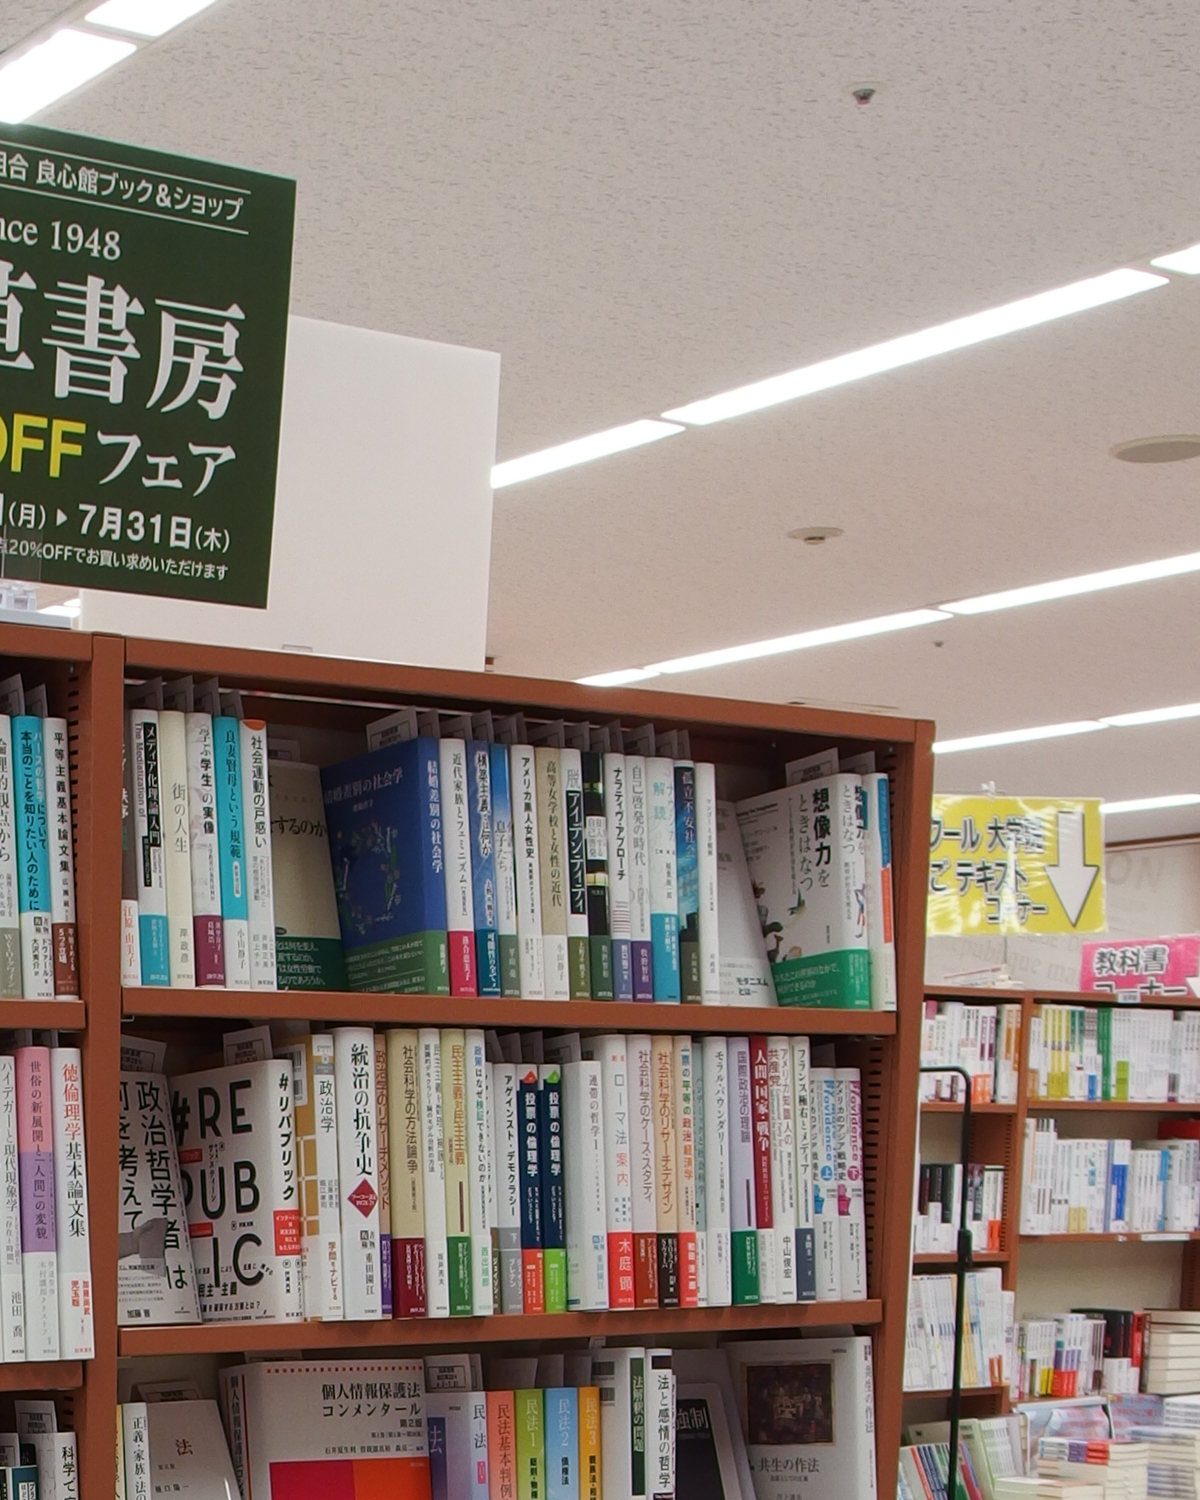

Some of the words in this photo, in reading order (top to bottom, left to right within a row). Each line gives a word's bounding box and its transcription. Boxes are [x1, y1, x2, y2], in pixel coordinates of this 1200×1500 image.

[36, 157, 244, 221] 良心館ブック&ショップ
[50, 219, 122, 260] 1948
[20, 731, 40, 911] 本当のことを知りたい人のために
[145, 725, 161, 846] メディア化理論入門
[172, 782, 189, 853] 街の人生
[225, 730, 242, 859] 良妻賢母という規範
[251, 736, 267, 849] 社会運動の戸惑い
[427, 760, 443, 873] 結婚差別の社会学
[546, 760, 563, 907] 高等女学校と女性の近代
[632, 765, 647, 868] 自己啓発の時代
[812, 787, 831, 888] 想像力を
[799, 794, 813, 891] ときはなつ
[1096, 947, 1168, 975] 教科書
[62, 1064, 85, 1238] 徳倫理学基本論文集
[278, 1072, 295, 1200] #リパブリック
[319, 1080, 334, 1132] 政治学
[351, 1044, 374, 1176] 統治の抗争史
[402, 1045, 418, 1174] 社会科学の方法論争
[614, 1074, 630, 1187] ローマ法案内
[321, 1382, 421, 1400] 個人情報保護法
[322, 1403, 422, 1418] コンメンタール
[657, 1375, 671, 1489] 法と感情の哲学
[758, 1458, 820, 1473] 共生の作法
